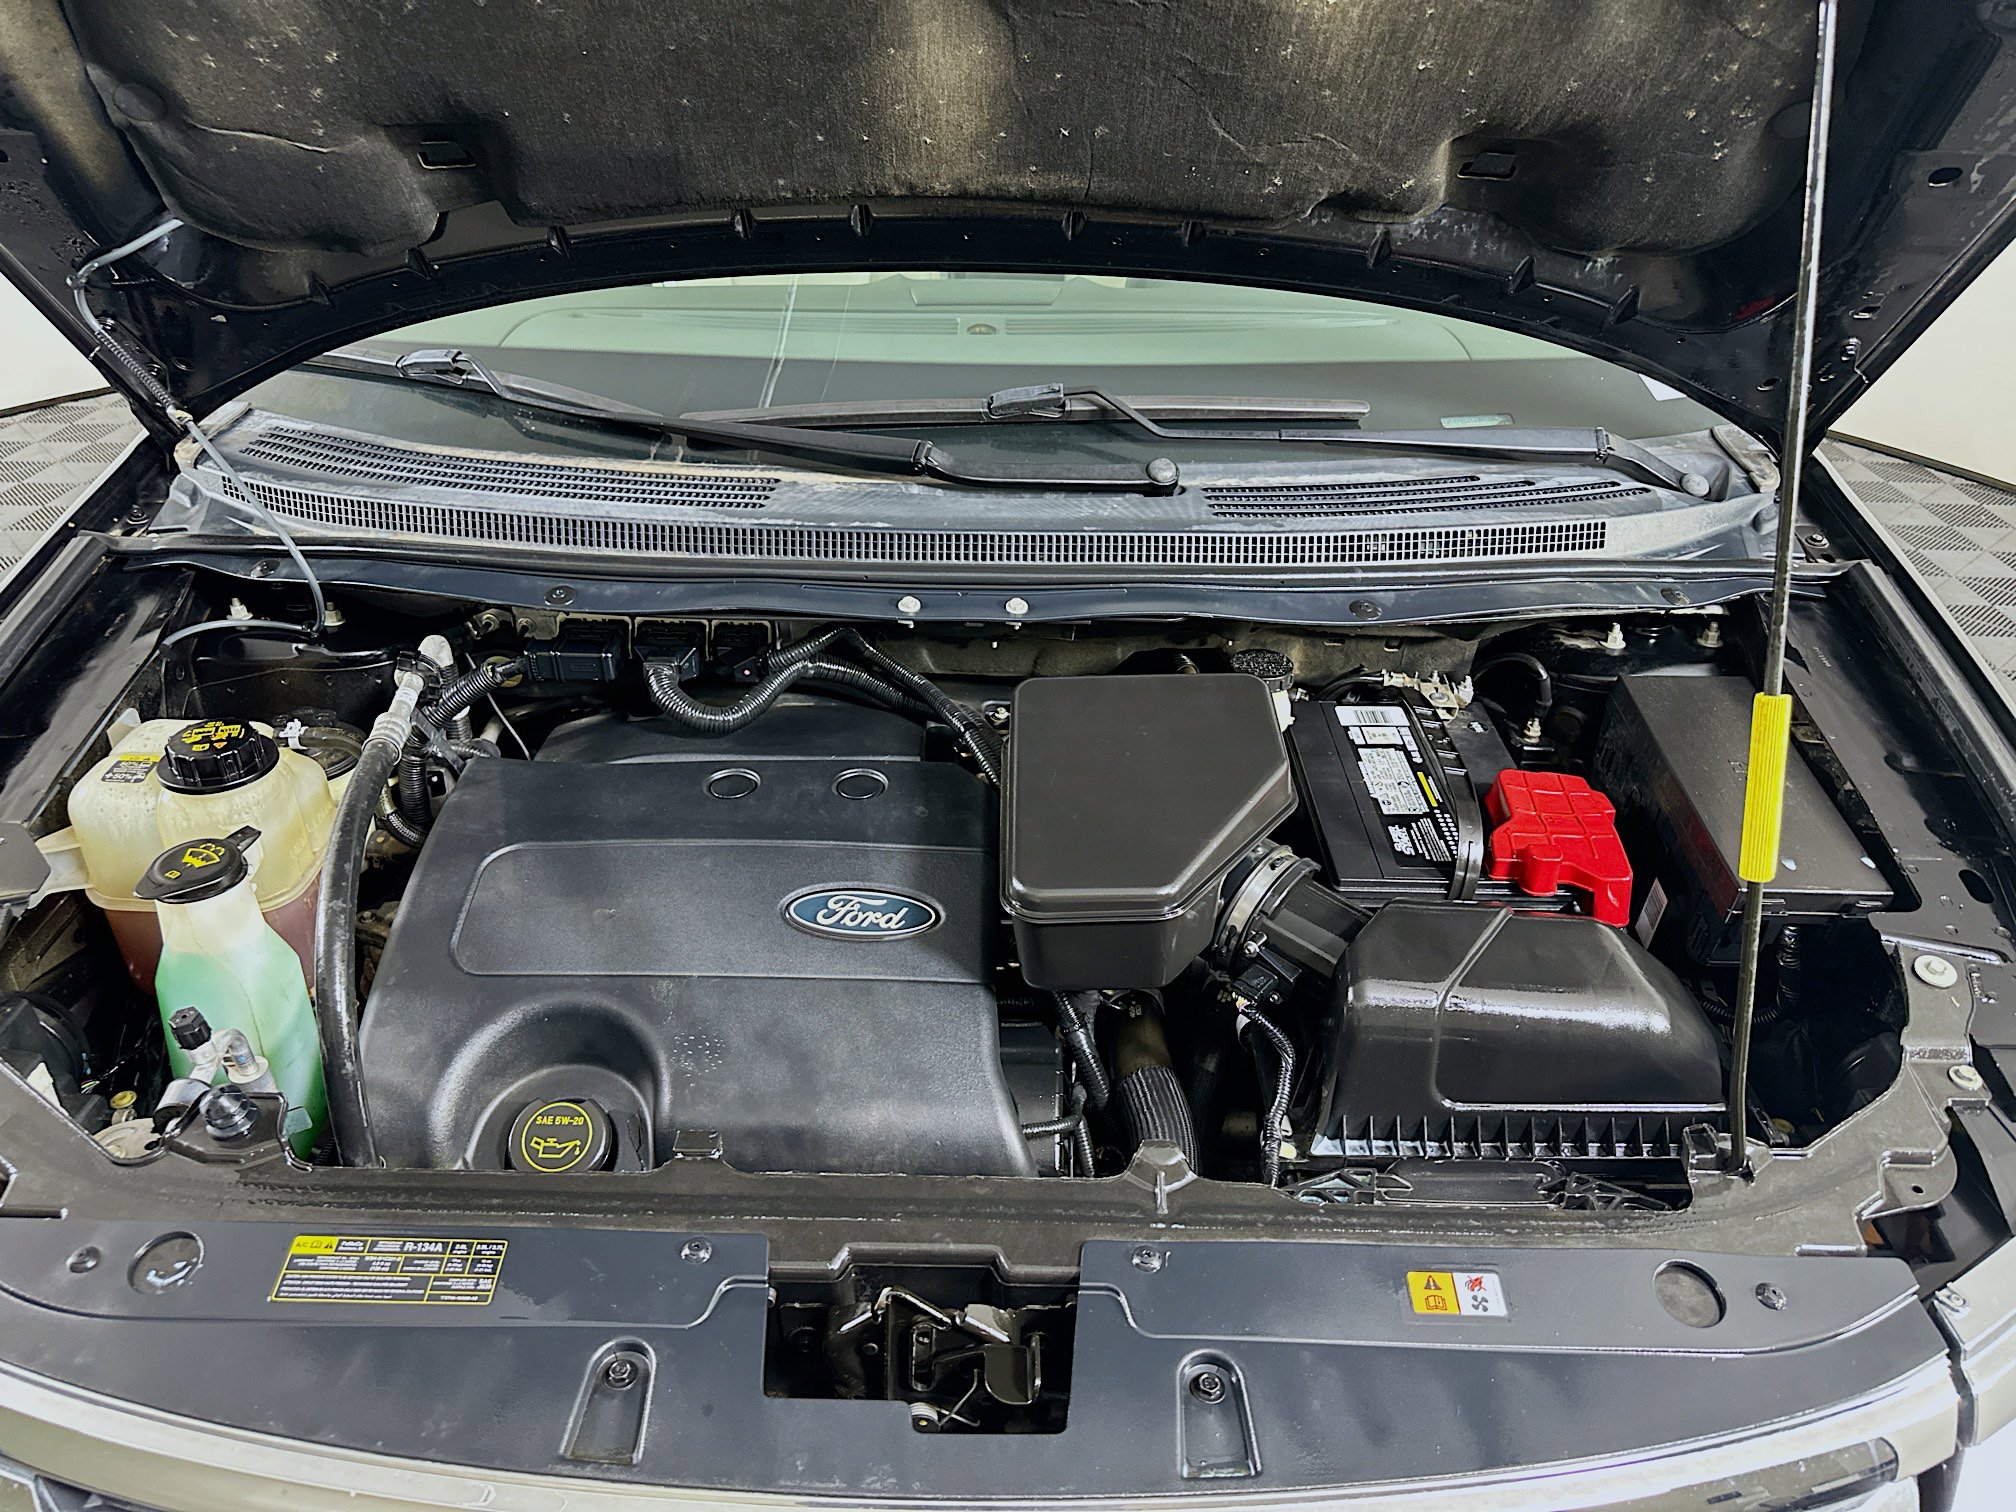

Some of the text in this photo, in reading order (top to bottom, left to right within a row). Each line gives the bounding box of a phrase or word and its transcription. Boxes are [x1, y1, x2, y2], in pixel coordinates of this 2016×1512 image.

[816, 894, 909, 930] Ford
[536, 1115, 585, 1125] SAE 5W-20
[295, 1240, 309, 1248] A/C
[403, 1241, 443, 1252] R-134A
